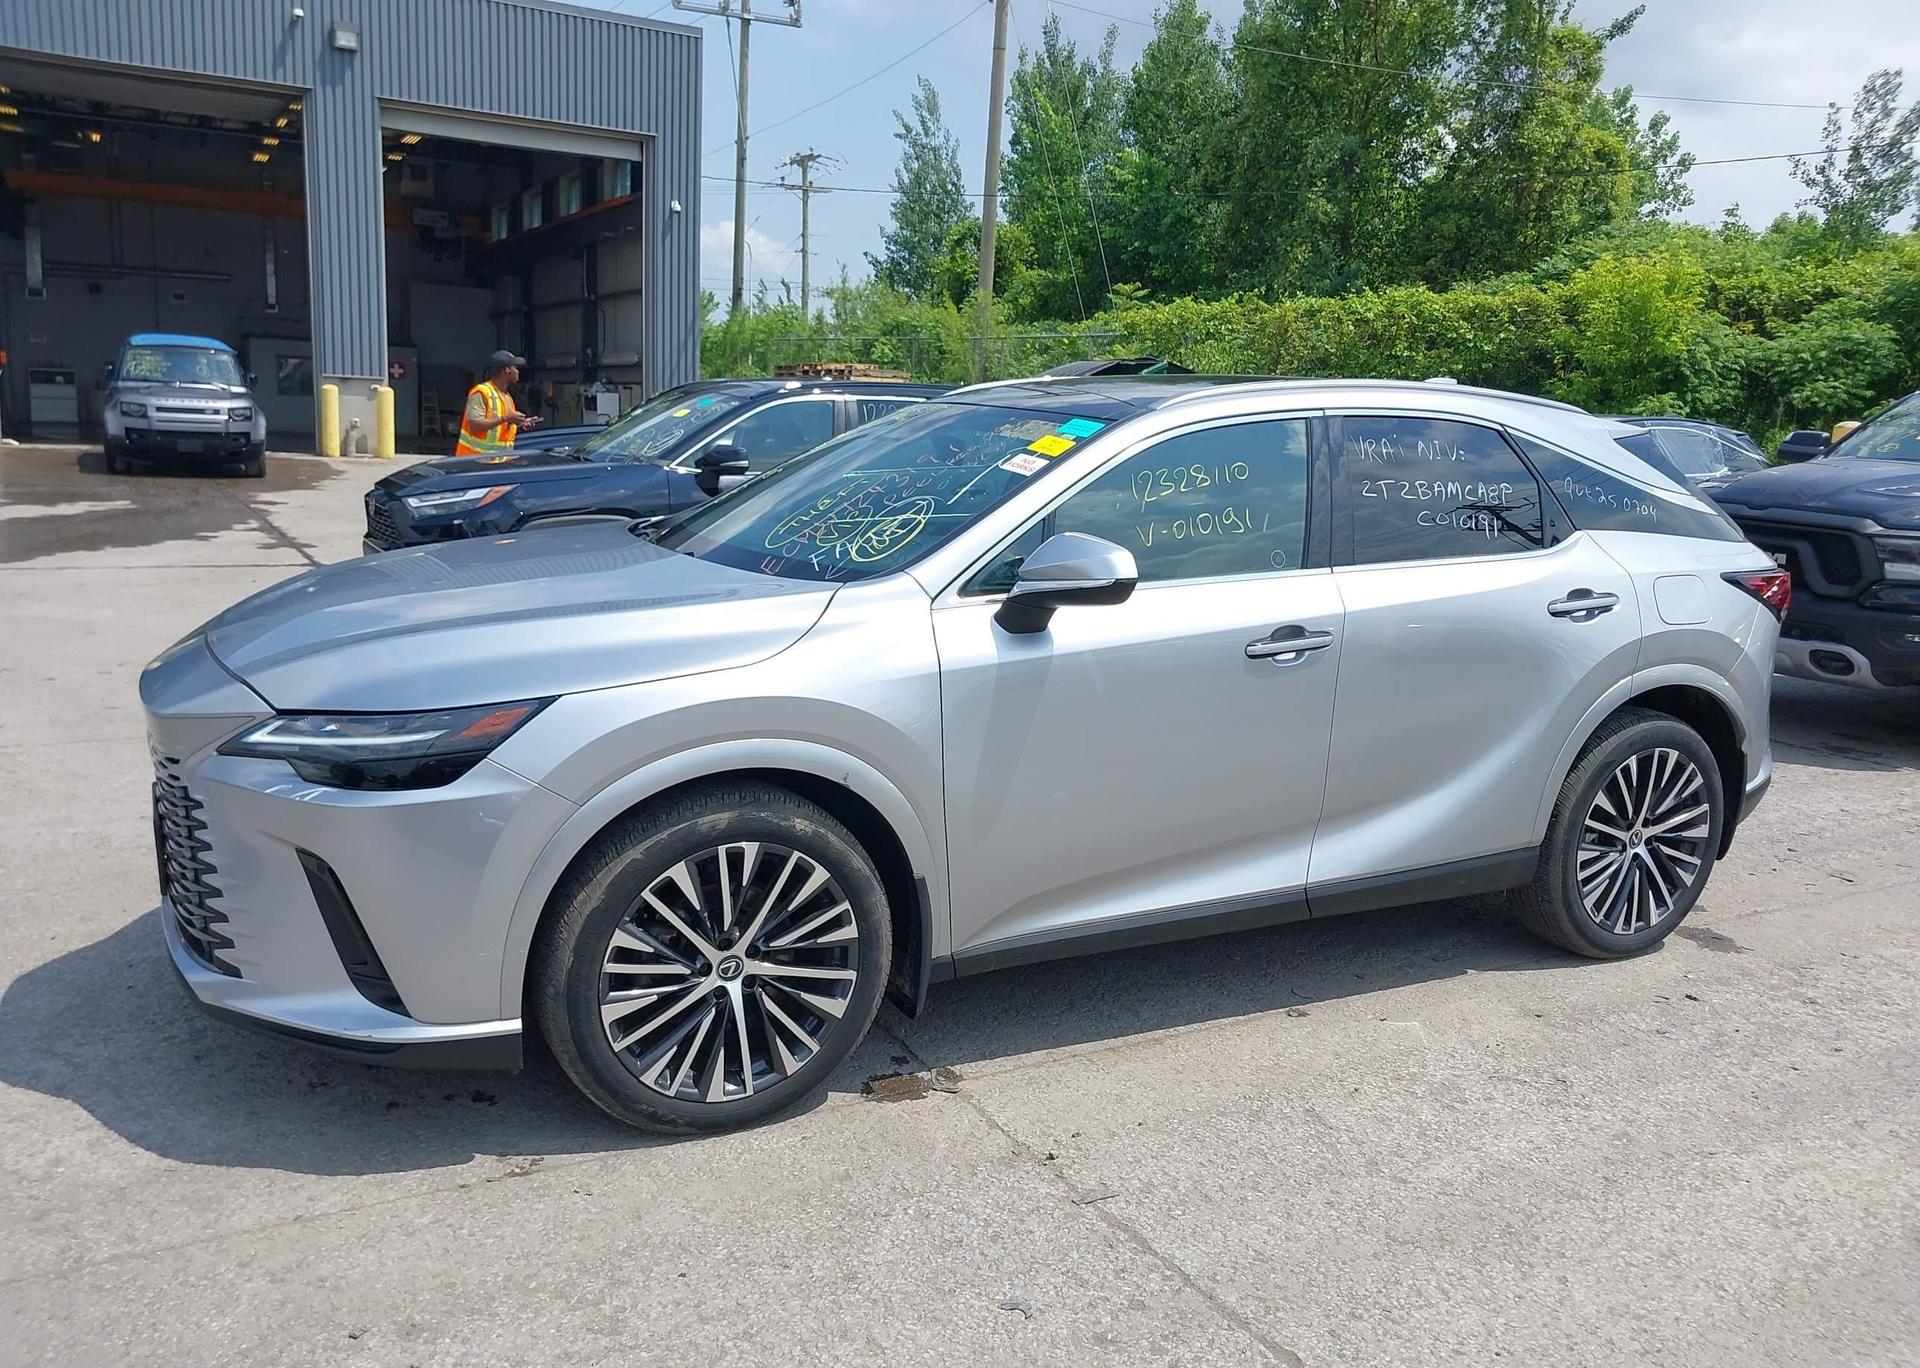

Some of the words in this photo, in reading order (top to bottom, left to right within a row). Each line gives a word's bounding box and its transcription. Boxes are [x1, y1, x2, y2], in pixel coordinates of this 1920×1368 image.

[1130, 461, 1249, 502] 12328110
[1361, 480, 1513, 505] 2T2BAMCA8P
[1136, 507, 1253, 547] V-010191
[1417, 511, 1498, 539] C010191
